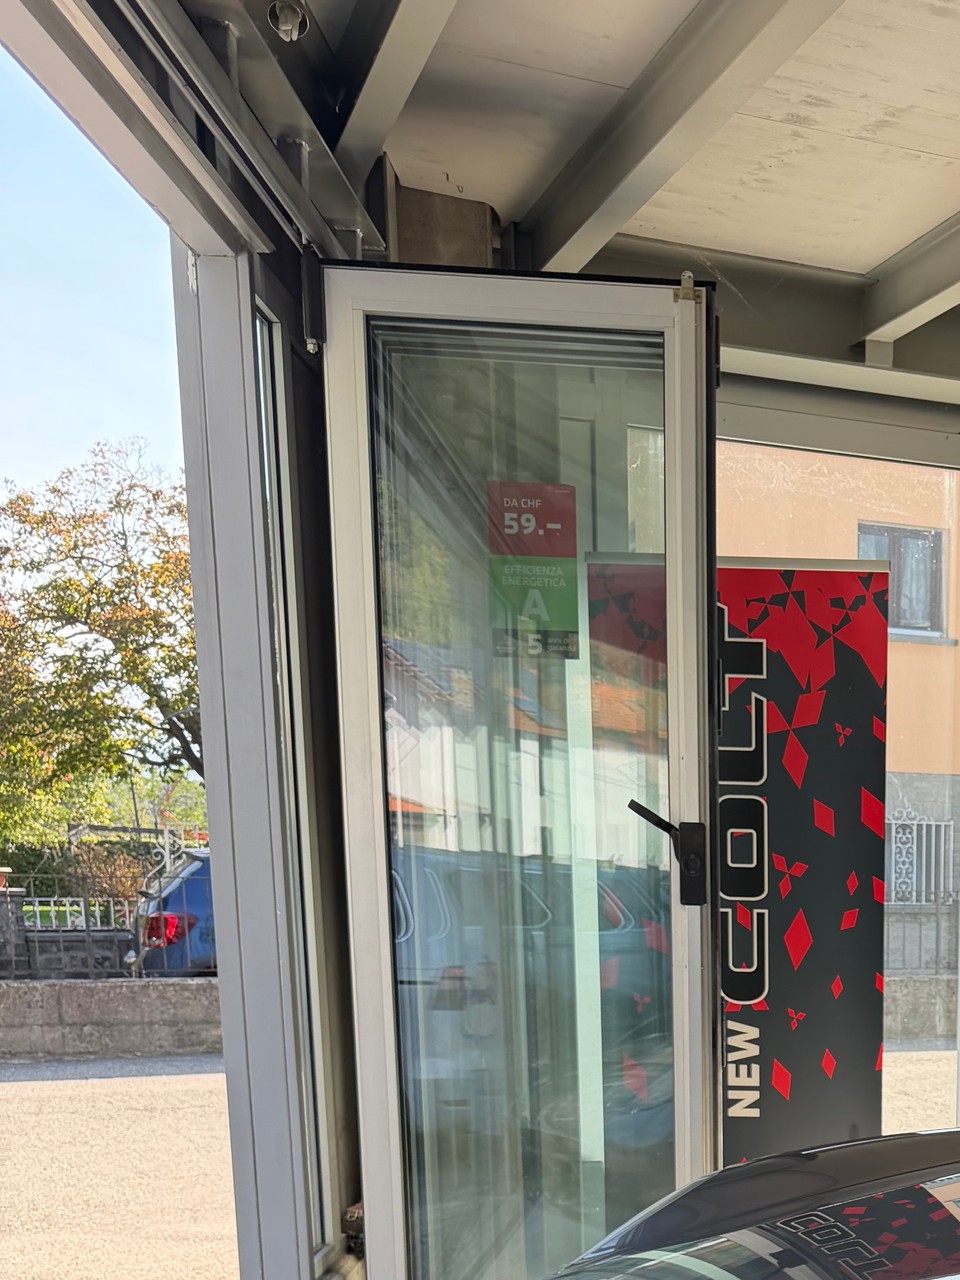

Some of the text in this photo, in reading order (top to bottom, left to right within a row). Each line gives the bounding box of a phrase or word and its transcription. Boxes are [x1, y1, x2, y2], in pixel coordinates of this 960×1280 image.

[503, 498, 542, 508] DA CHF
[503, 564, 564, 577] EFFICIENZA
[501, 576, 567, 588] ENERGETICA
[521, 588, 550, 622] A
[527, 633, 543, 655] 5
[717, 602, 769, 1118] NEW COLT
